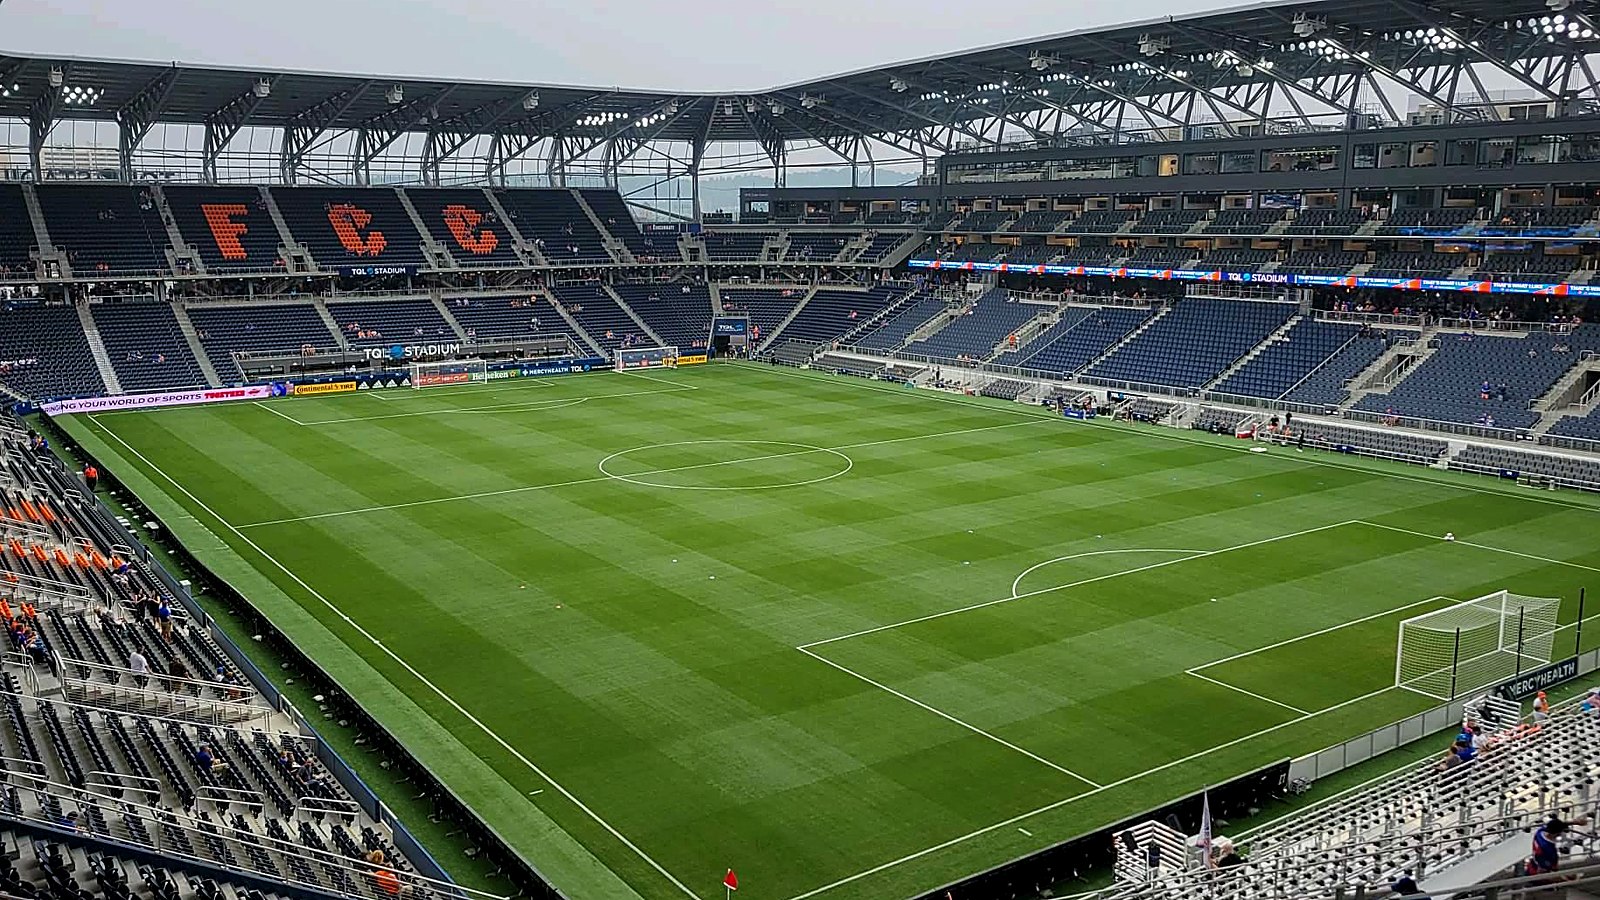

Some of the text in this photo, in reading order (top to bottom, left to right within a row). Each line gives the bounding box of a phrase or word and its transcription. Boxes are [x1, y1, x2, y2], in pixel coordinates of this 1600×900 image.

[201, 203, 499, 260] F C C
[1251, 274, 1288, 282] STADIUM
[364, 344, 460, 359] TQL STADIUM
[530, 366, 568, 375] MERCYHEALTH
[472, 372, 508, 380] Heineken
[296, 384, 333, 393] Continental
[108, 398, 145, 406] WORLD
[162, 394, 202, 402] SPORTS
